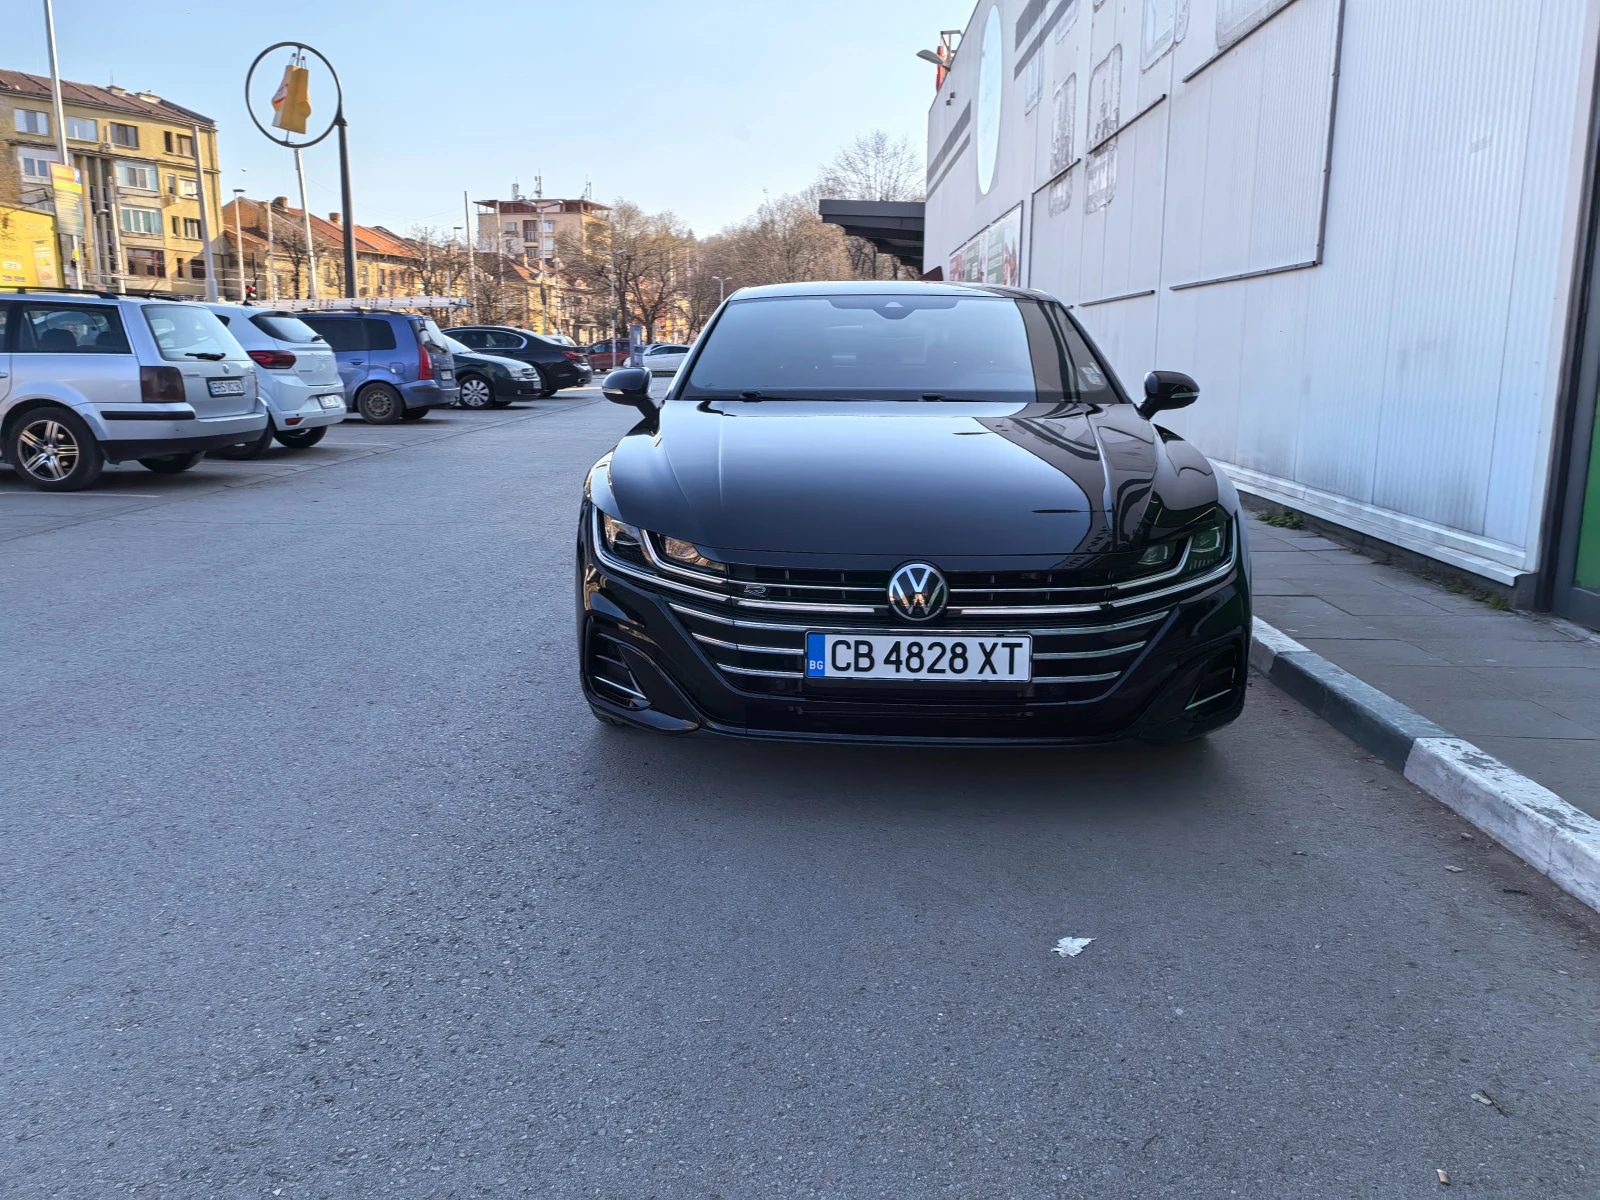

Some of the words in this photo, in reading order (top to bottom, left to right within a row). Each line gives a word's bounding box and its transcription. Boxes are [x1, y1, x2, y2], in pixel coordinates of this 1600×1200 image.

[809, 660, 824, 670] BG
[831, 639, 875, 673] CB
[883, 640, 969, 674] 4828
[977, 641, 1024, 676] XT
